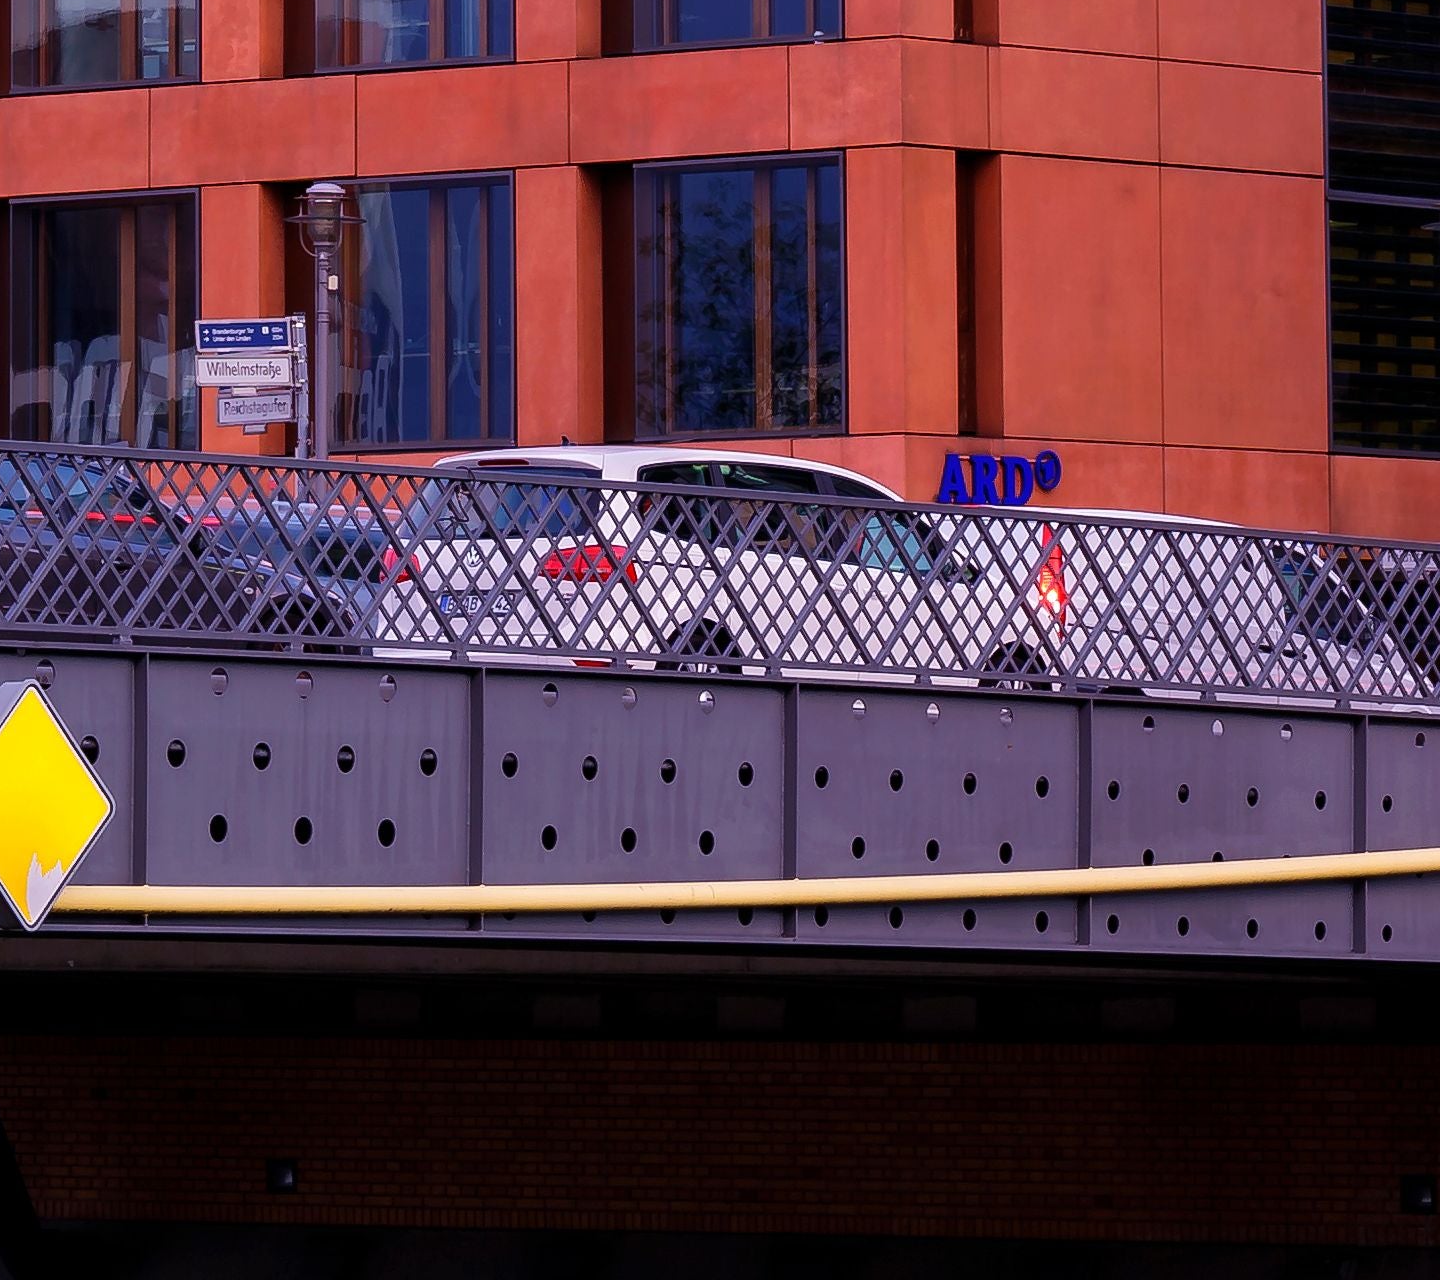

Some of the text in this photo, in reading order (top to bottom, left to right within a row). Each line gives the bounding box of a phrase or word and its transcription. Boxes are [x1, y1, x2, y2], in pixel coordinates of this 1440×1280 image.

[206, 361, 282, 379] Wilhelmstraße
[223, 397, 287, 416] Reichstagufer
[935, 453, 1034, 506] ARD
